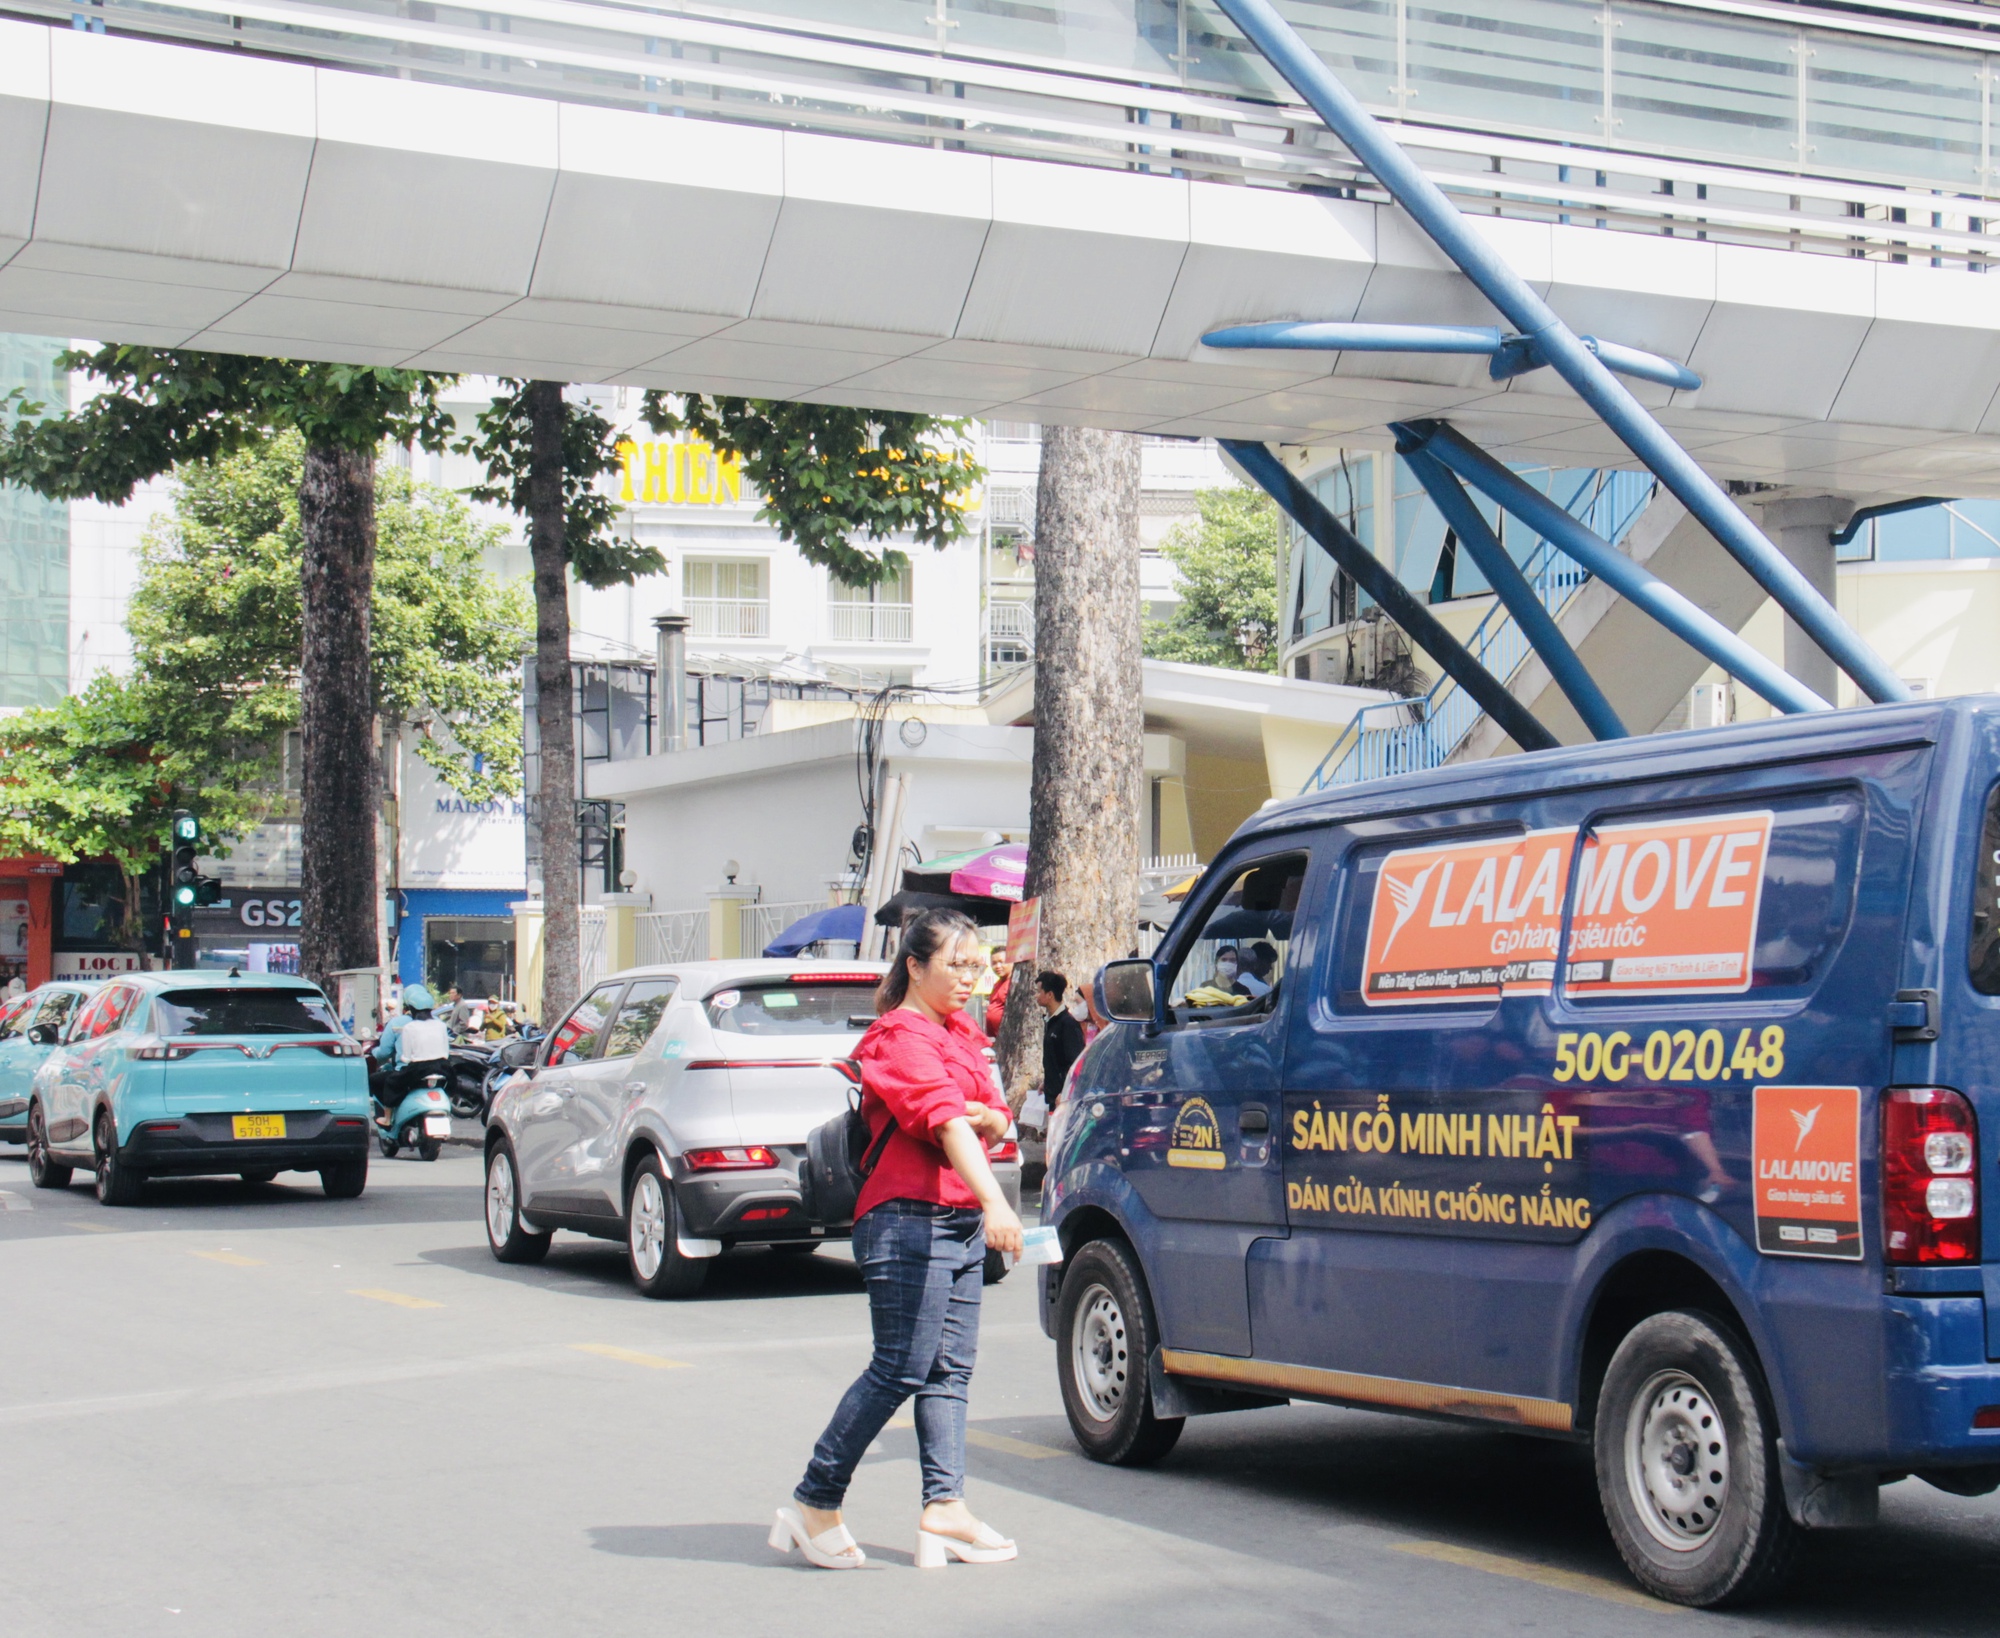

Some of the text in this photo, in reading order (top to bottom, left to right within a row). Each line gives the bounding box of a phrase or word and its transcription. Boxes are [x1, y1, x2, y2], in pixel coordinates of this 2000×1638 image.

[436, 799, 505, 814] MAISON
[182, 820, 196, 838] 19
[1429, 830, 1762, 928] LALAMOVE
[240, 899, 302, 927] GS2
[1577, 921, 1614, 950] siêu
[1612, 915, 1647, 948] tốc
[79, 957, 120, 971] LOC
[1459, 969, 1481, 985] Theo
[1505, 964, 1527, 981] 24/7
[1552, 1024, 1785, 1083] 50G-020.48
[240, 1126, 280, 1137] 578.73
[247, 1116, 270, 1126] 50H
[1193, 1125, 1213, 1149] 2N
[1291, 1094, 1580, 1174] SÀN GỖ MINH NHẬT
[1759, 1159, 1853, 1182] LALAMOVE
[1288, 1175, 1592, 1230] DÁN CỬA KÍNH CHỐNG NẮNG
